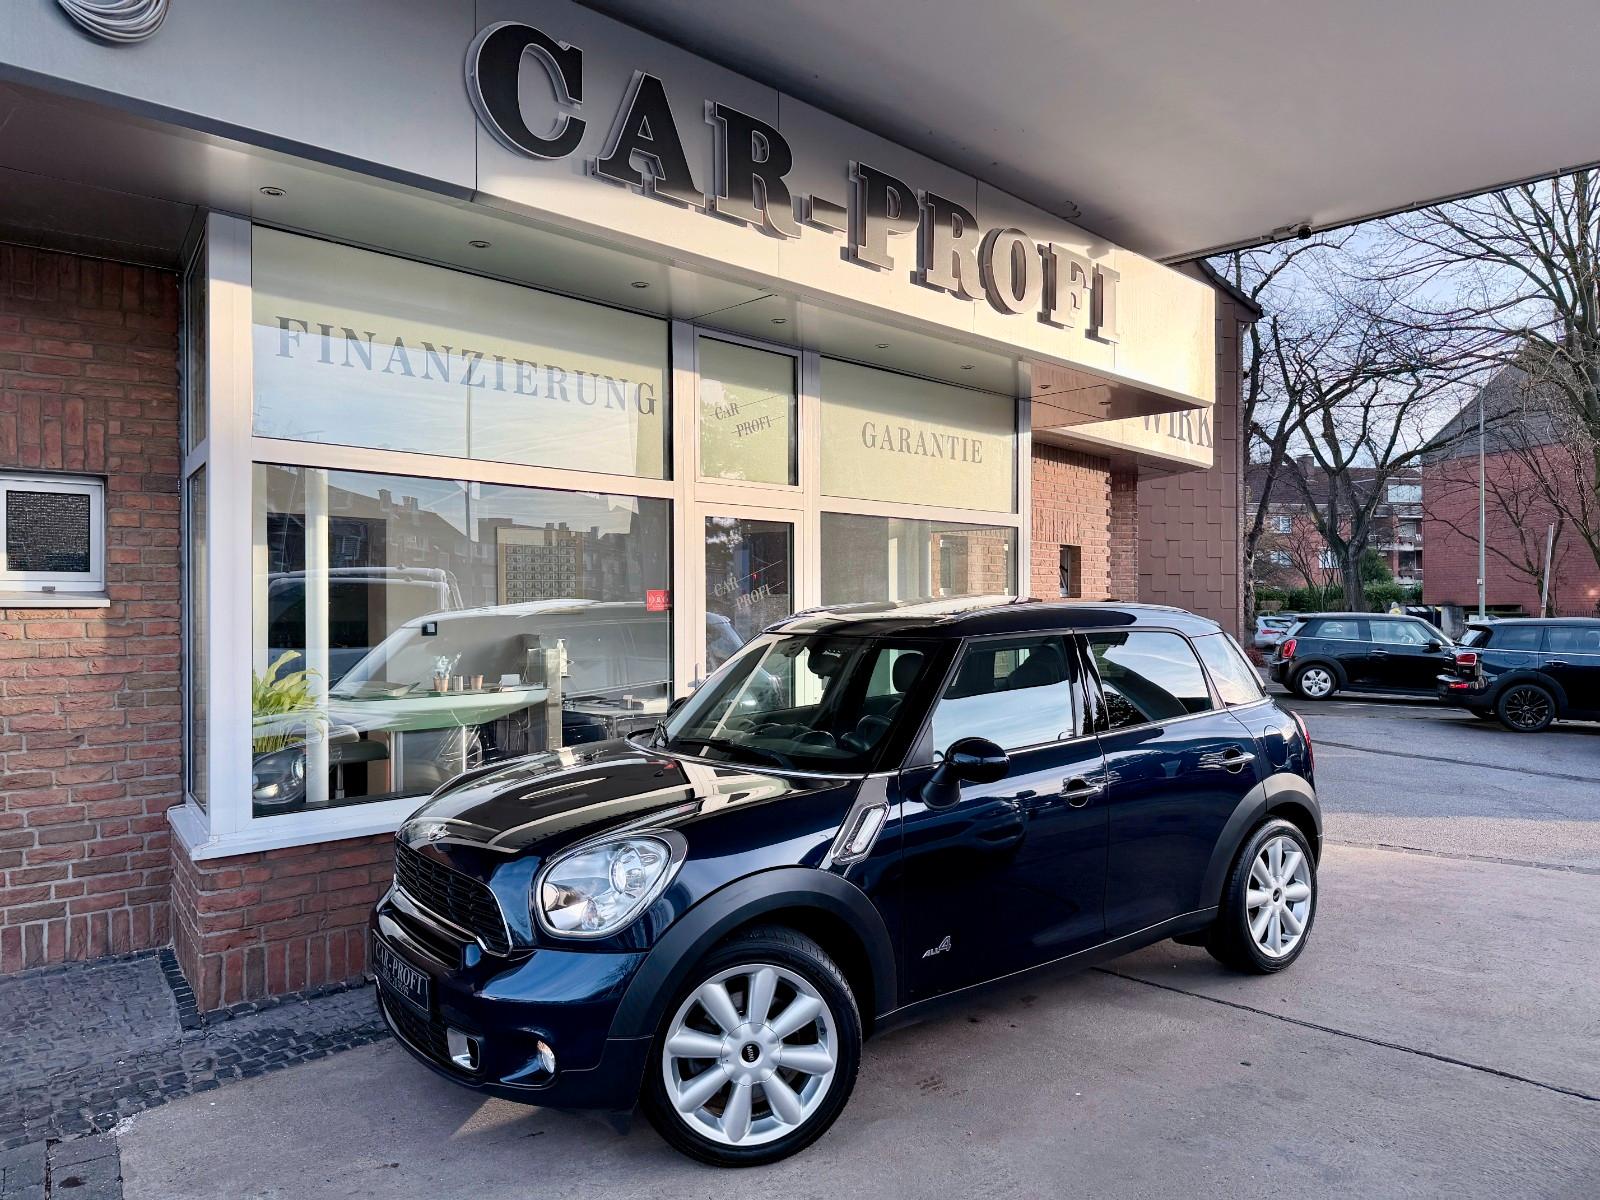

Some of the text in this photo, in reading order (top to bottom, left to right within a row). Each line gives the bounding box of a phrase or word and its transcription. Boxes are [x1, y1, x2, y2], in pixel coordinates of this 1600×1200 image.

[466, 20, 1121, 345] CAR-PROFI
[275, 315, 658, 417] FINANZIERUNG
[714, 402, 740, 421] CAR
[736, 415, 771, 437] PROFI
[862, 421, 984, 464] GARANTIE
[713, 576, 740, 597] CAR
[735, 583, 771, 610] PROFI
